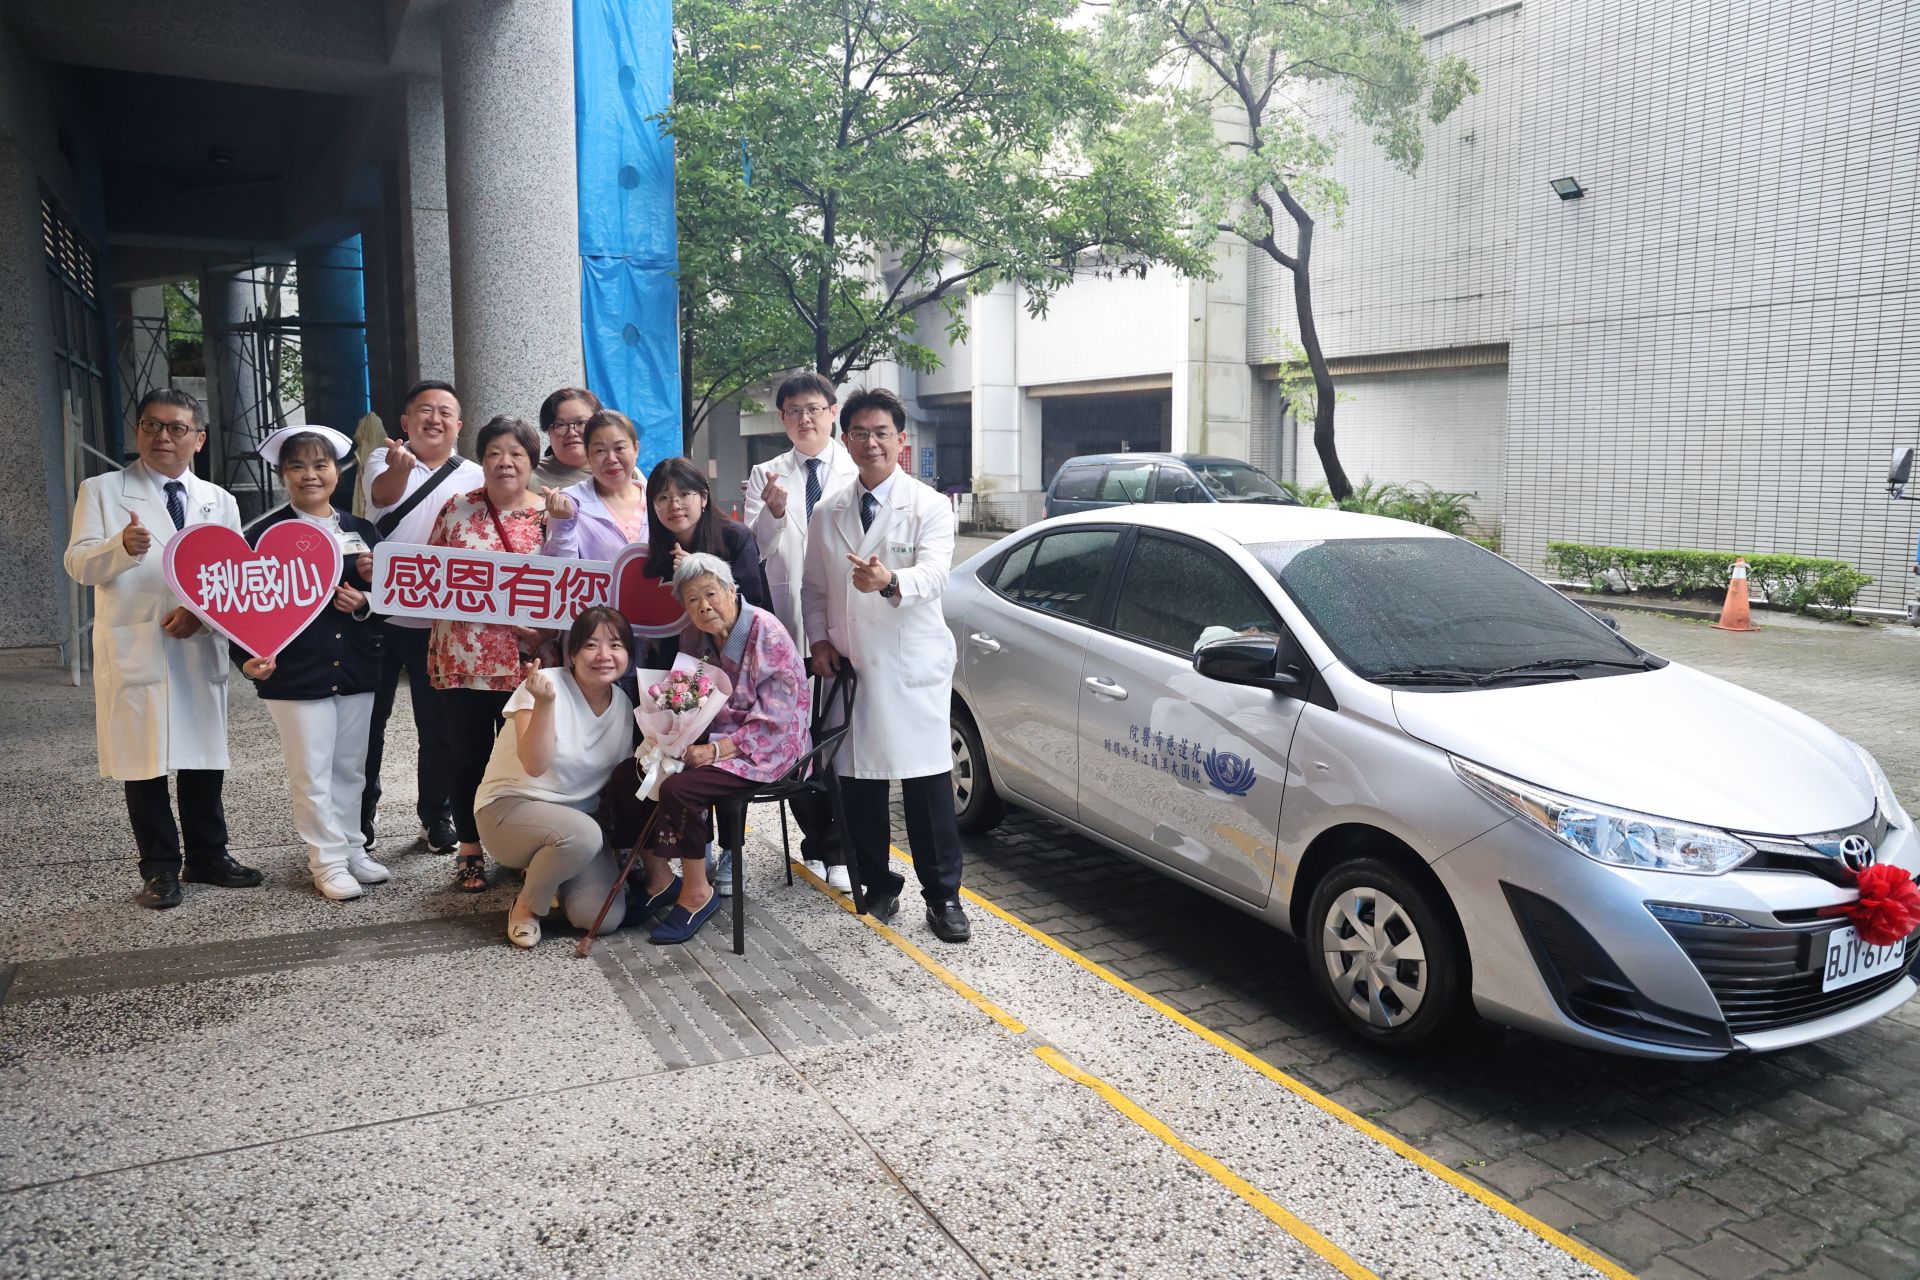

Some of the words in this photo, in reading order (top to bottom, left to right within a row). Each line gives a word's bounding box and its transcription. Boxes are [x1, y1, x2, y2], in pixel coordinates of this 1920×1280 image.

[197, 555, 324, 614] 揪感心
[384, 554, 611, 621] 感恩有您
